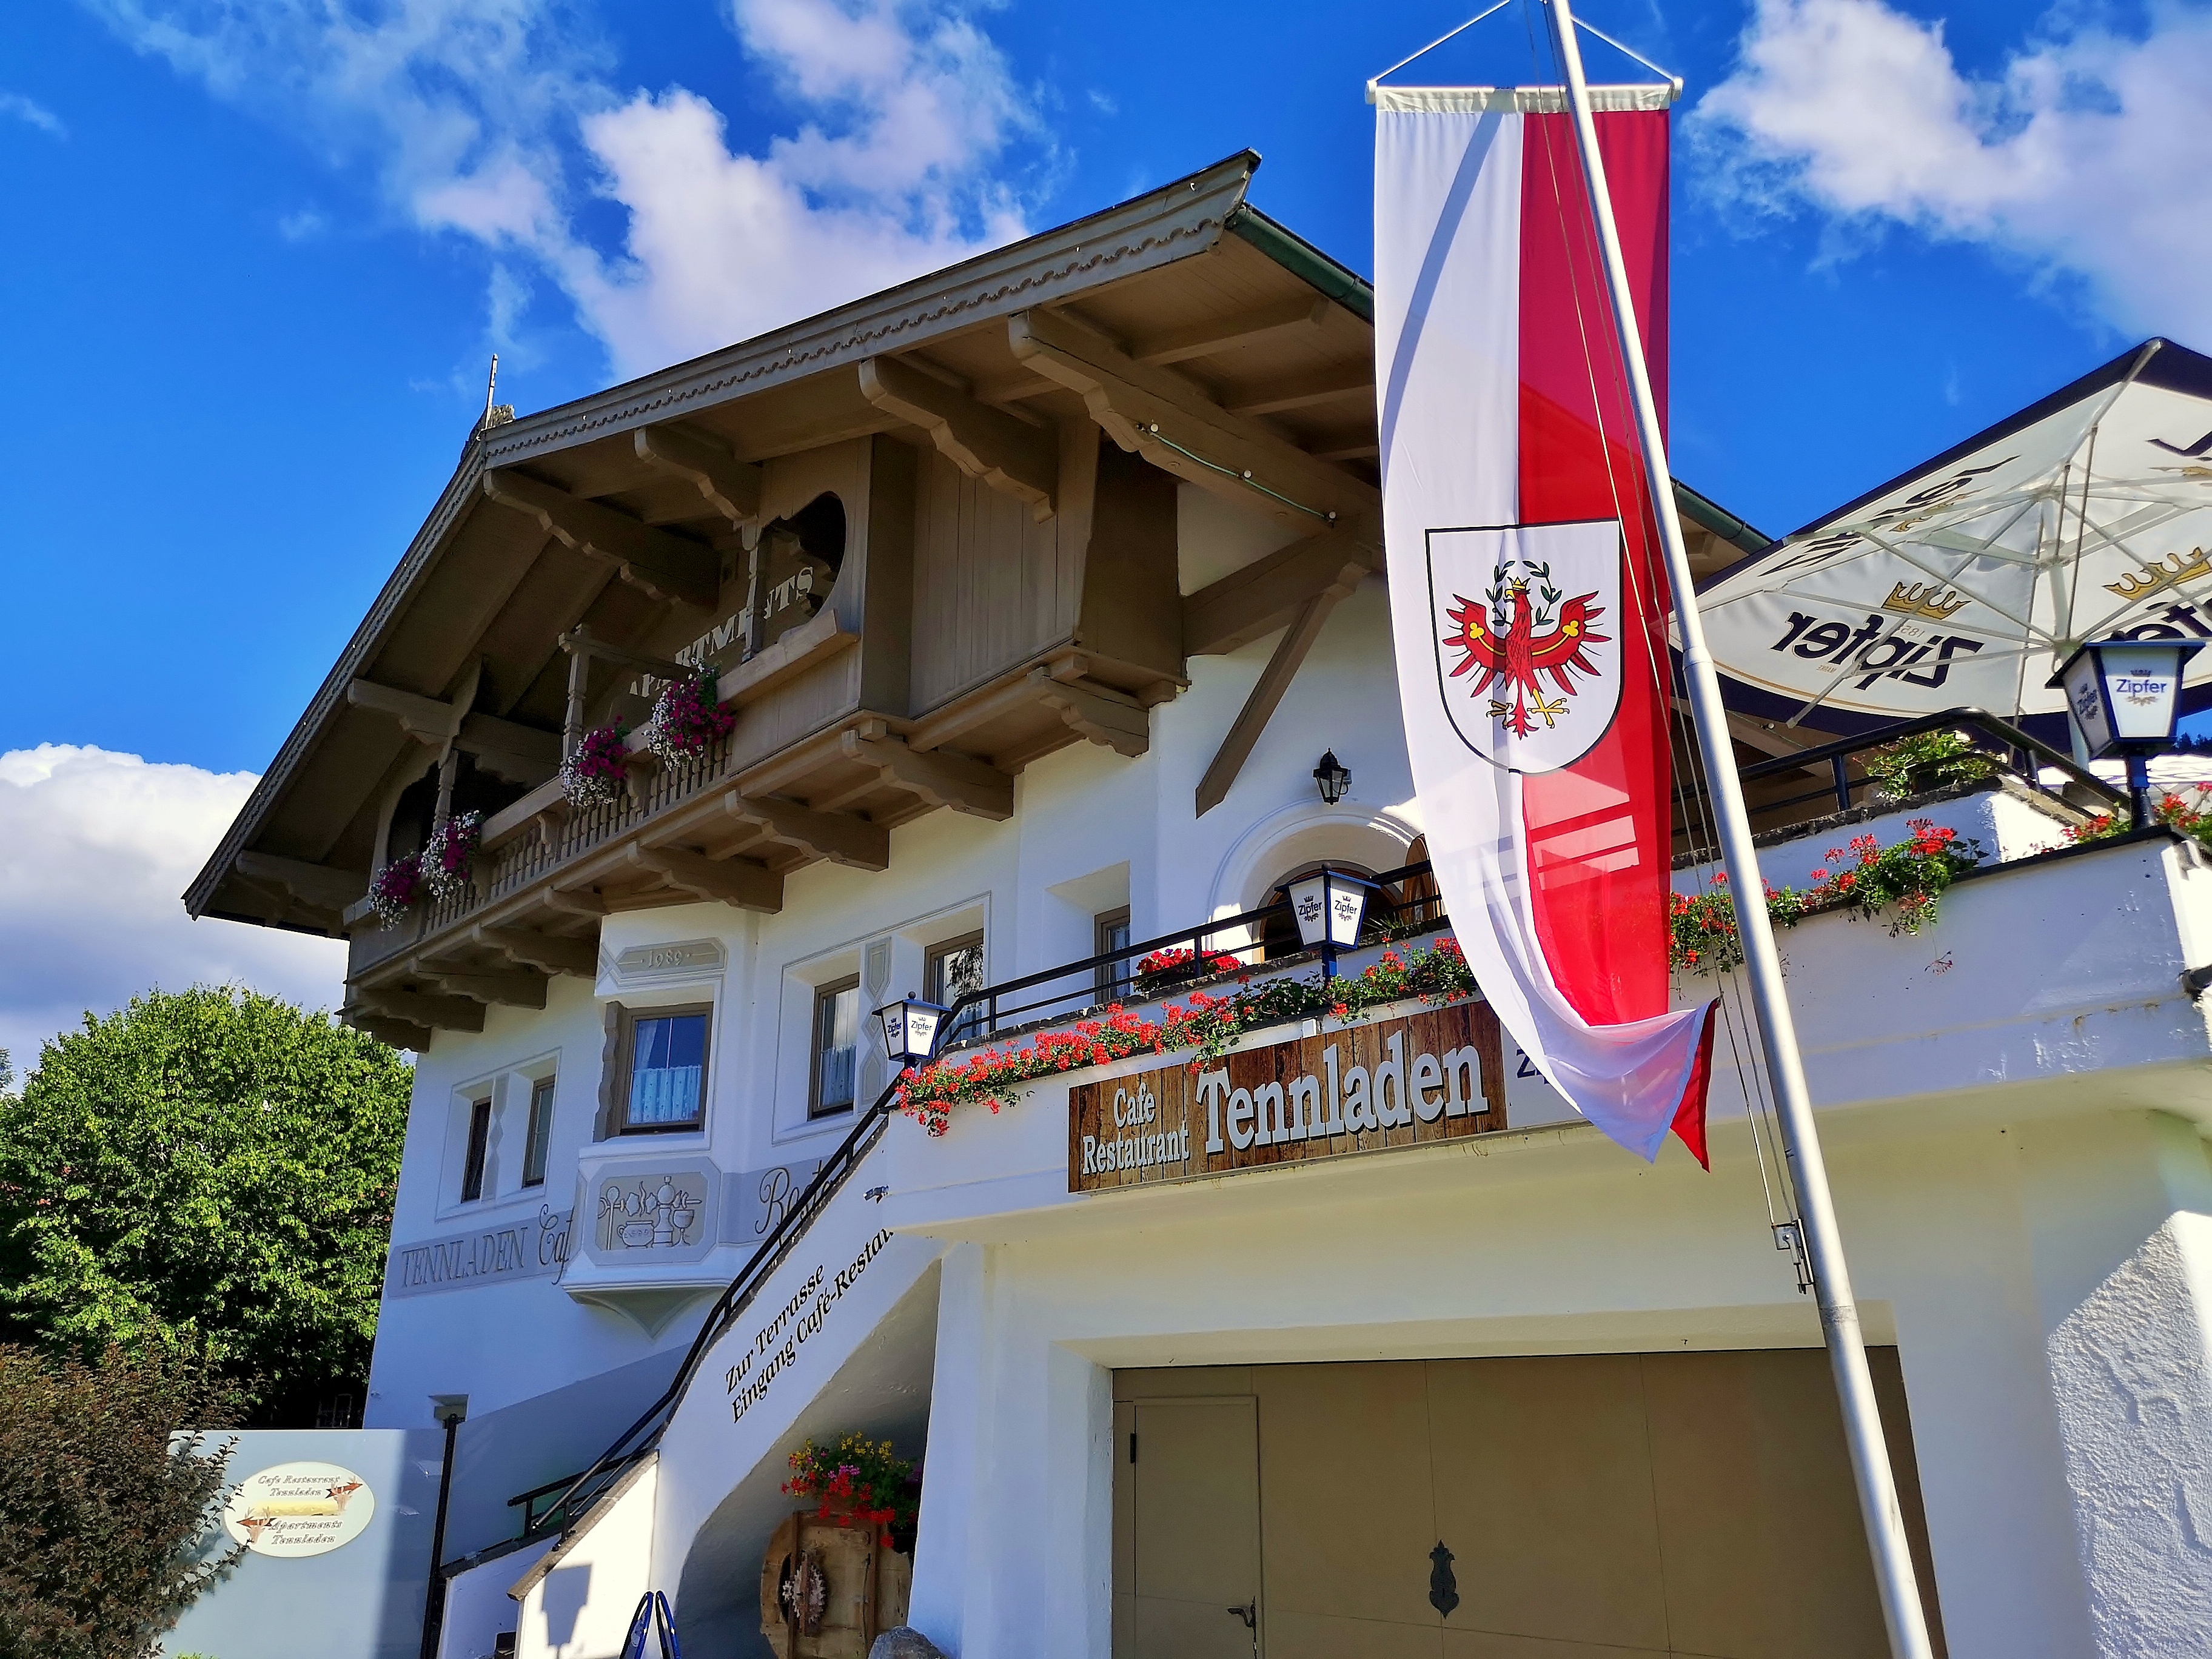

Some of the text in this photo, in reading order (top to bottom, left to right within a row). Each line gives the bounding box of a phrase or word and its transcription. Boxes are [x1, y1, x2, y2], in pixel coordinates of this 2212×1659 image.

[2116, 679, 2167, 697] Zipfer
[1298, 901, 1322, 916] Zipfer
[1335, 900, 1358, 915] Zipfer
[911, 1020, 933, 1031] Zipfer
[1196, 1030, 1490, 1155] Tennladen
[1113, 1082, 1156, 1128] Cafe
[1082, 1121, 1190, 1175] Restaurant
[402, 1227, 528, 1287] TENNLADEN
[726, 1264, 824, 1395] Zur Terrasse
[732, 1335, 796, 1424] Eingang
[270, 1487, 323, 1496] Tennladen
[268, 1520, 343, 1533] Apartments
[272, 1533, 336, 1544] Tennladen
